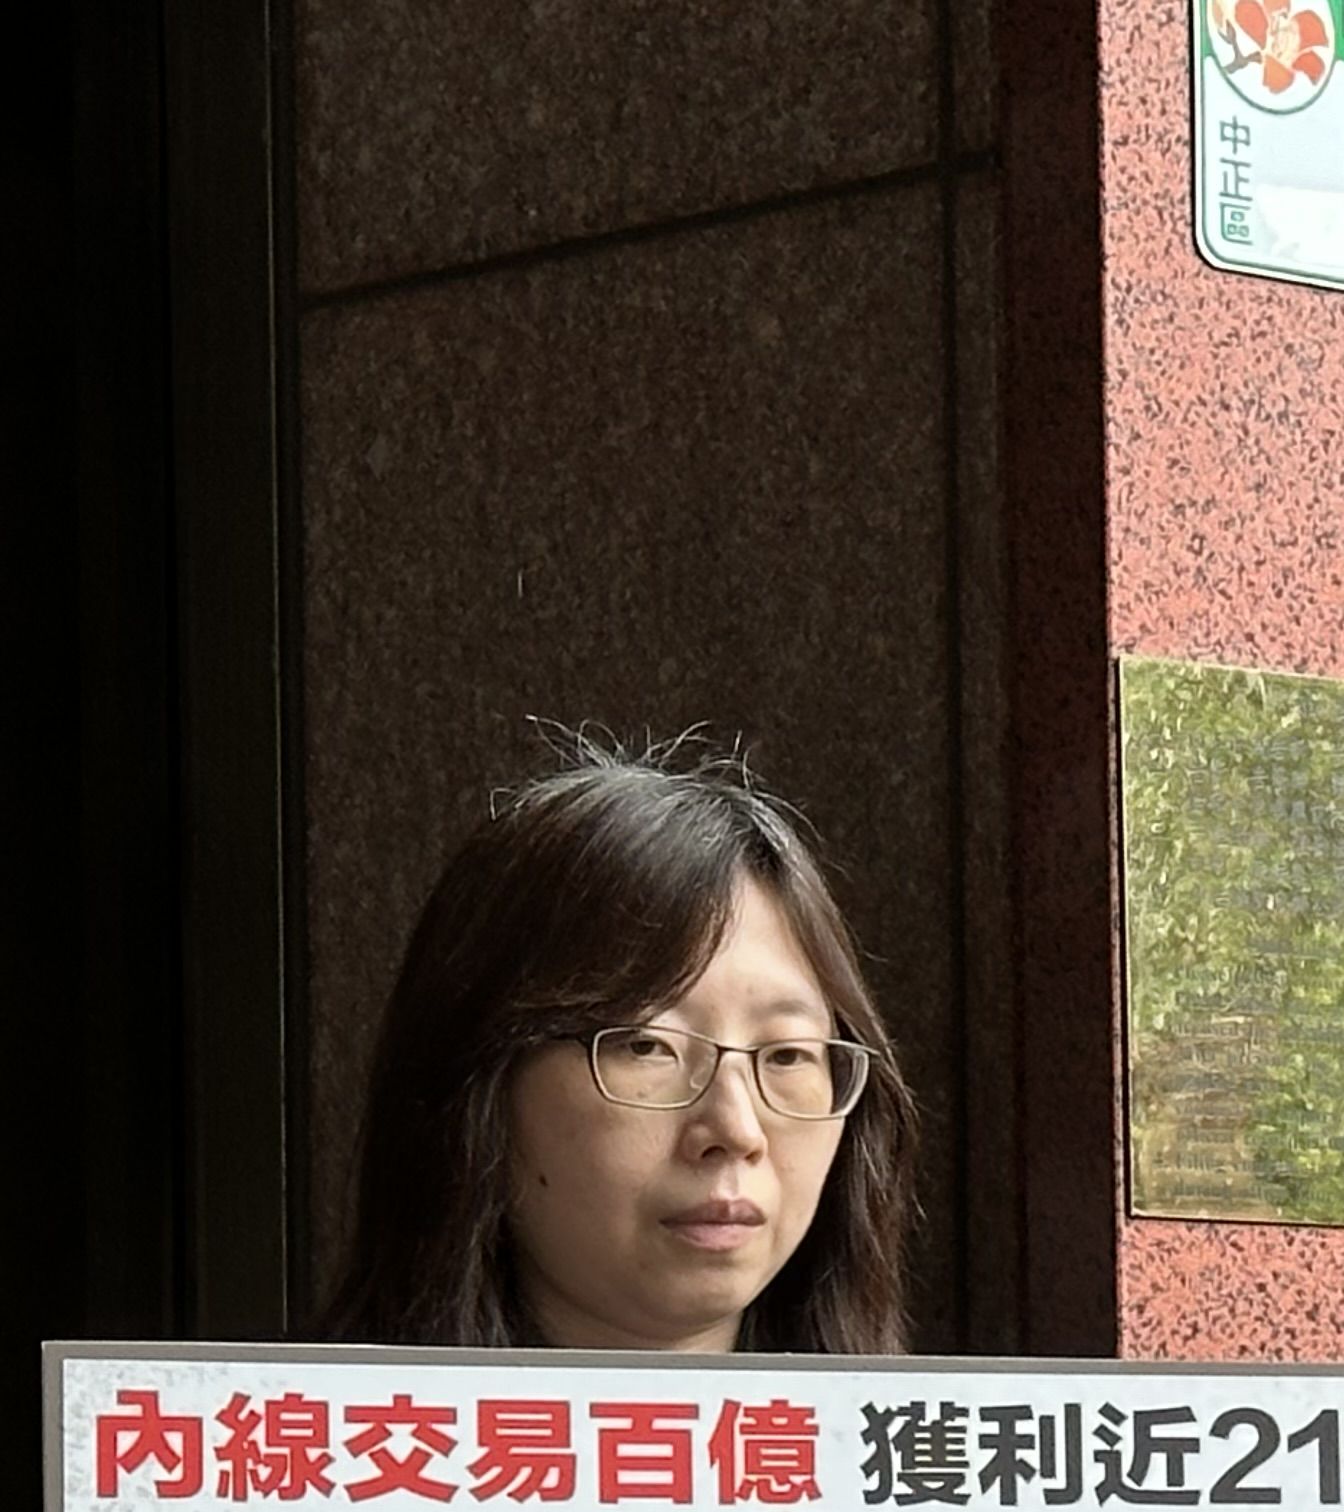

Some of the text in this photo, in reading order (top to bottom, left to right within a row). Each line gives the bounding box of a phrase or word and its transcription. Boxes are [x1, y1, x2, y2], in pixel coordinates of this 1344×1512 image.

[1219, 116, 1253, 246] 中正區
[96, 1390, 821, 1504] 內線交易百億
